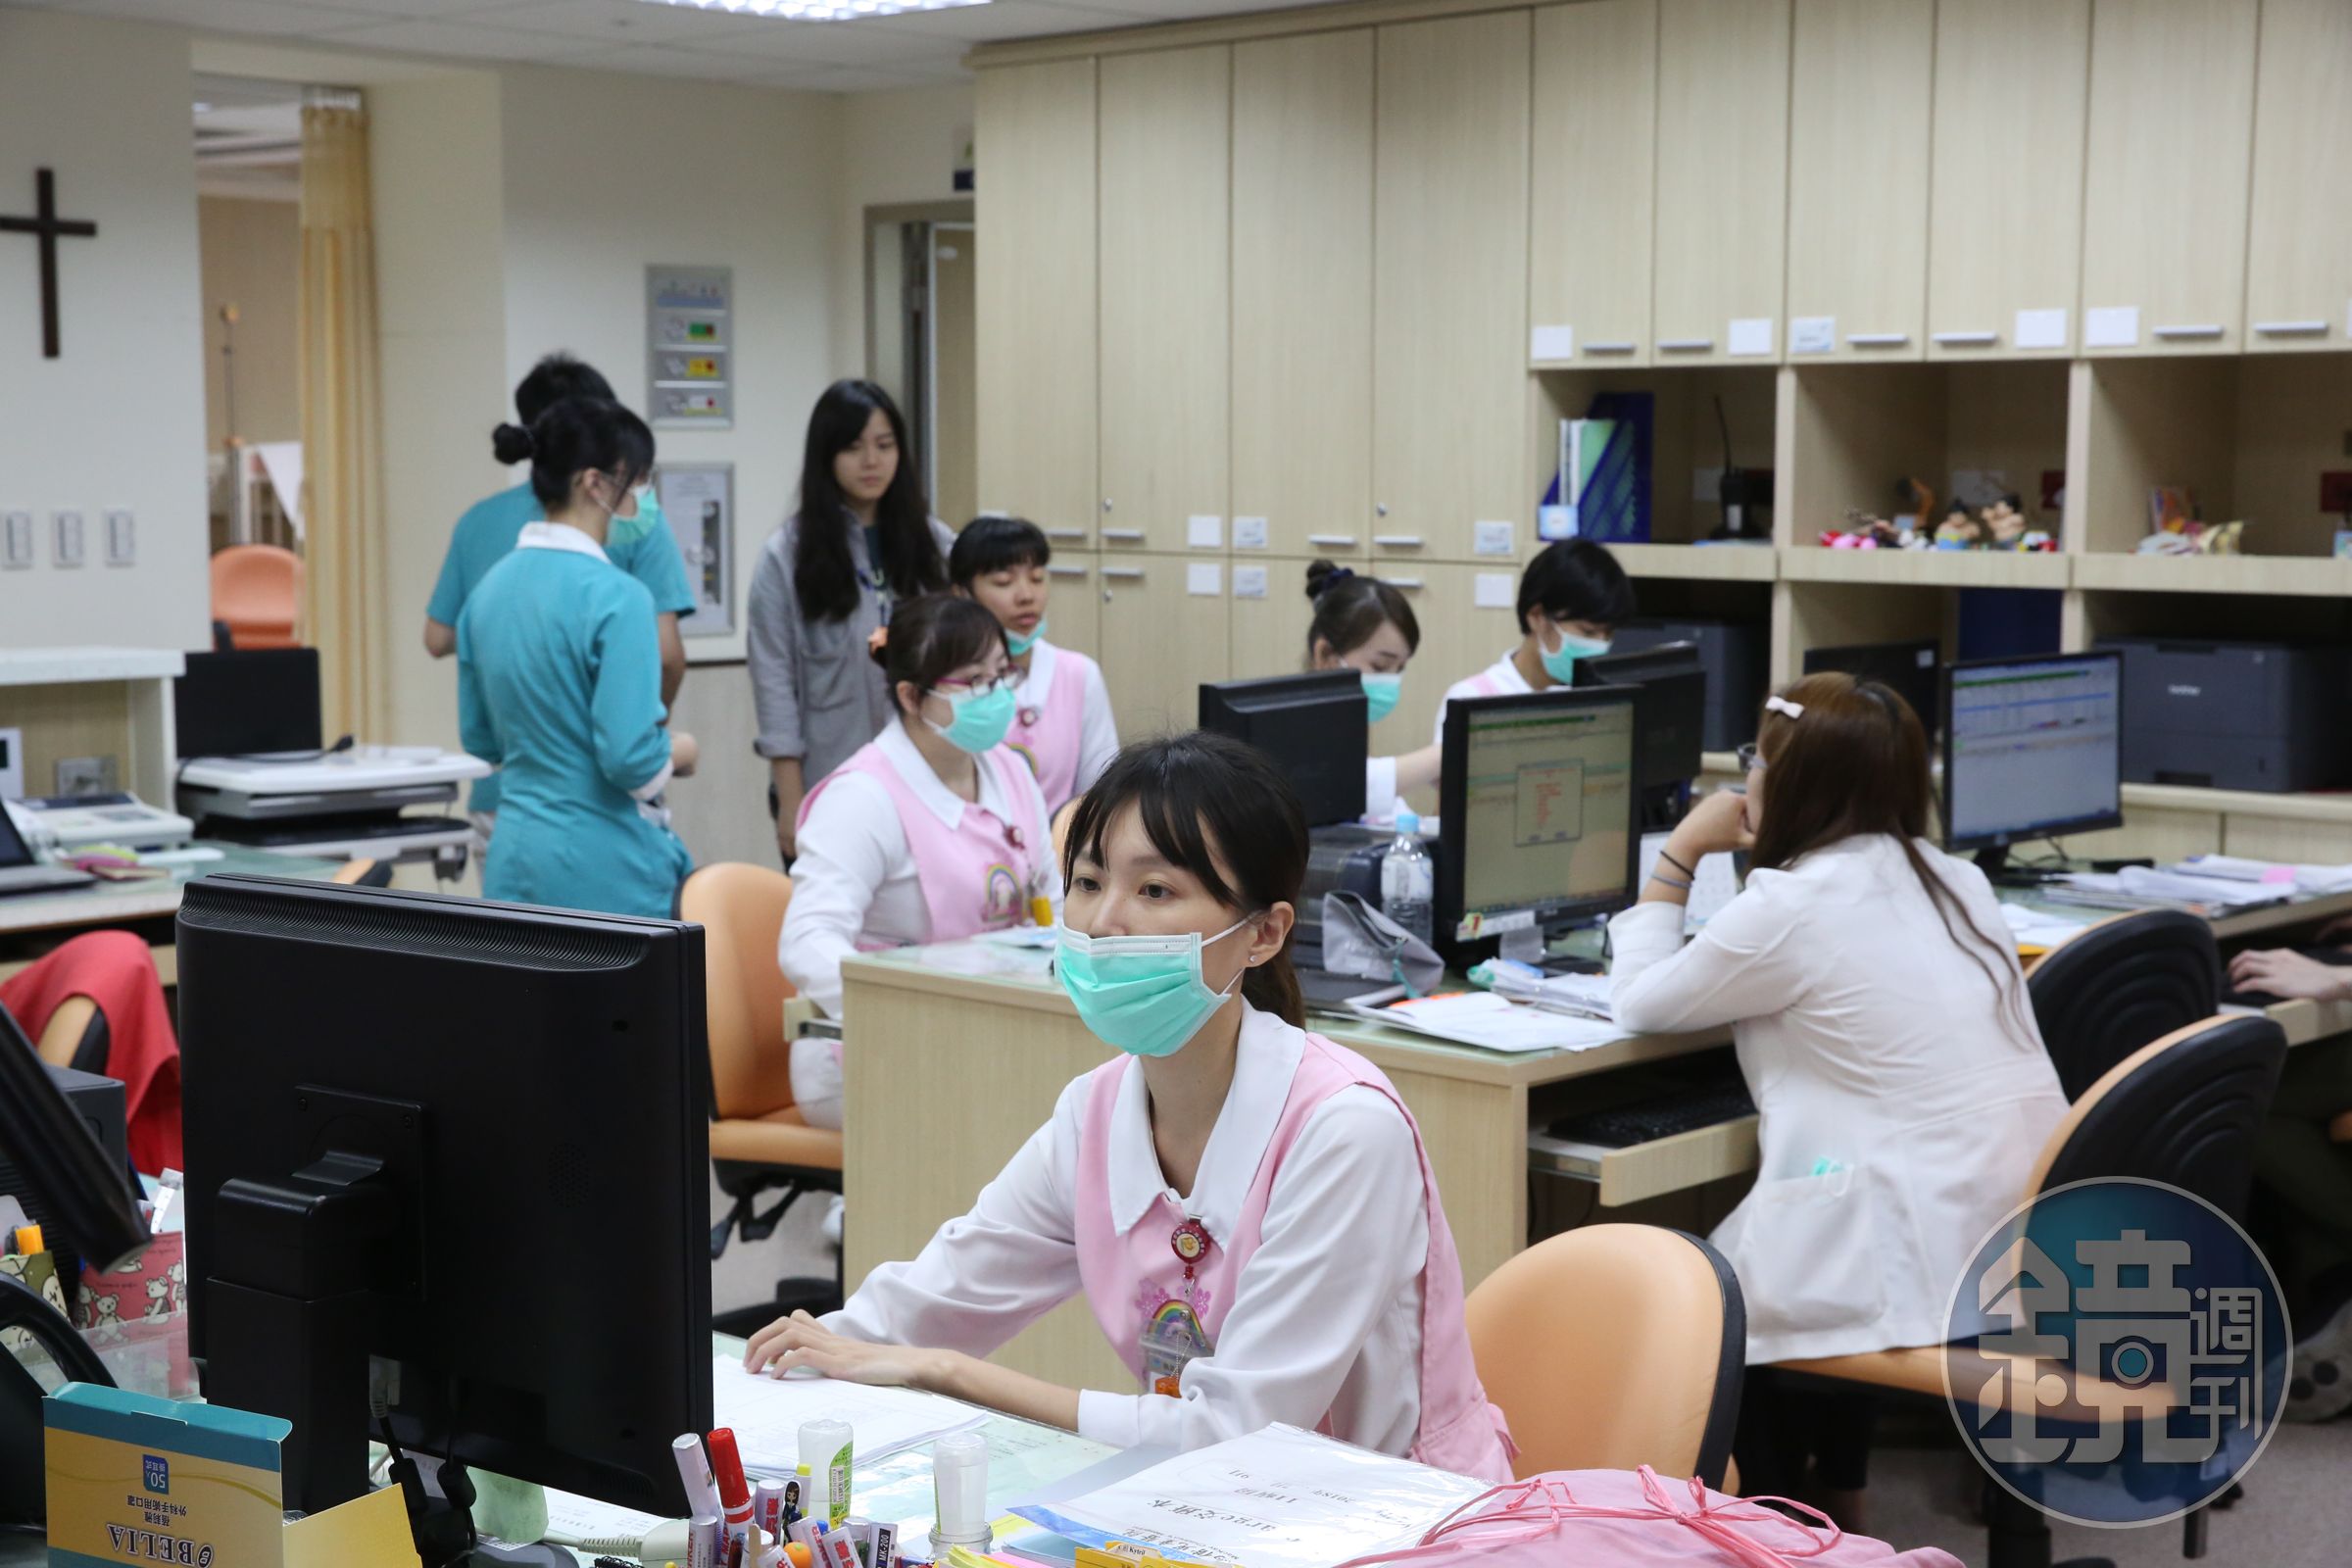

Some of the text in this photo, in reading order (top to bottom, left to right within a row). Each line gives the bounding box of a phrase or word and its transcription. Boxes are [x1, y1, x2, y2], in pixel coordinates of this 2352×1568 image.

[127, 1494, 186, 1517] 外科手術用口罩
[878, 1534, 889, 1562] MK-200
